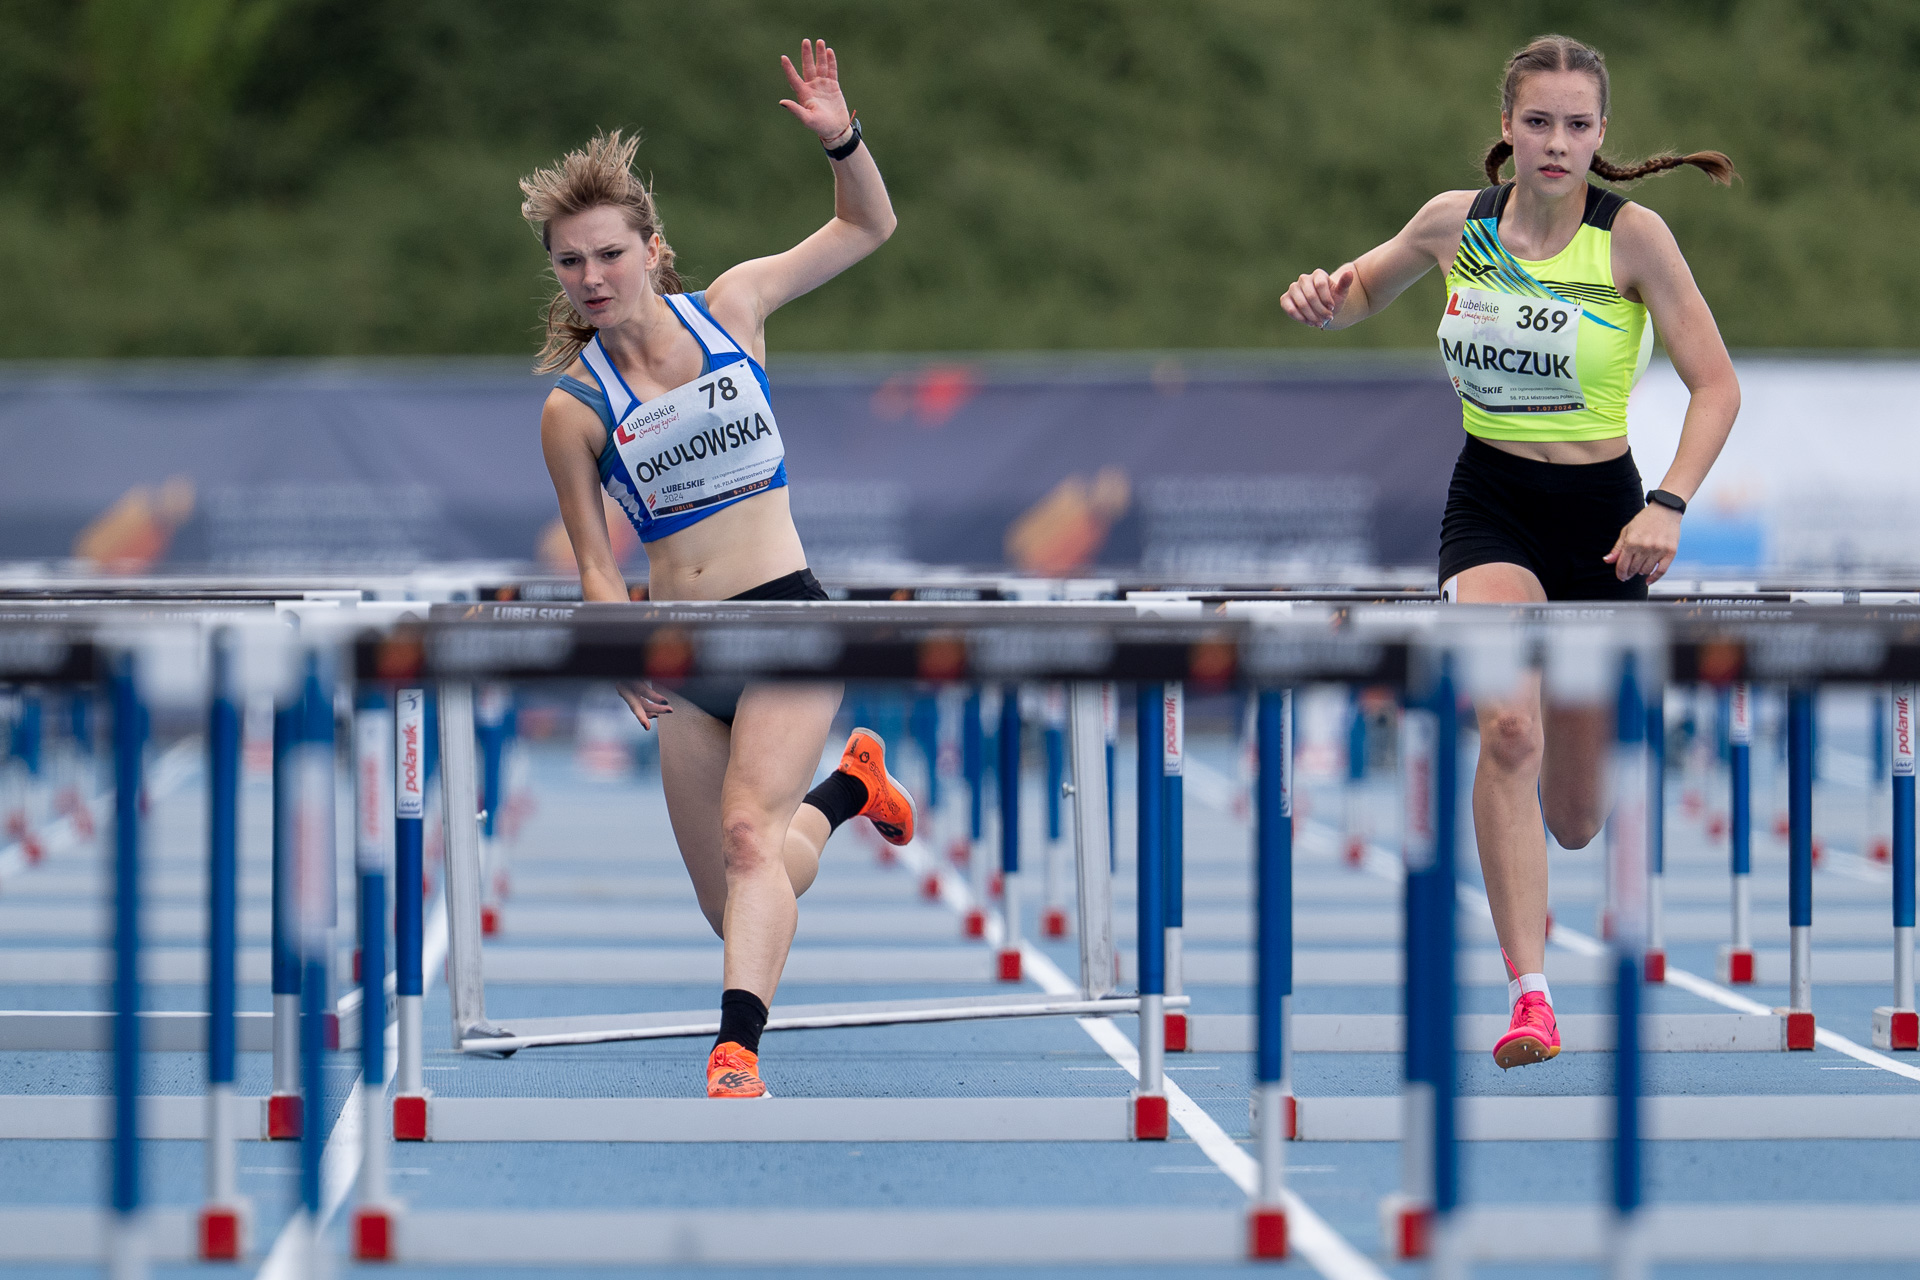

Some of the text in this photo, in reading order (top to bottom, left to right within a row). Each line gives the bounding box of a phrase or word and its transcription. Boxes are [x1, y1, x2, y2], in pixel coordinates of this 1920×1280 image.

[1460, 298, 1568, 333] lubelskie 369
[1442, 338, 1573, 379] MARCZUK
[698, 376, 738, 409] 78
[1464, 379, 1503, 394] LUBELSKIE
[627, 404, 675, 431] lubelskie
[636, 412, 773, 483] OKULOWSKA
[662, 478, 705, 494] LUBELSKIE
[664, 492, 684, 503] 2024
[671, 503, 694, 513] LUBLIN
[493, 606, 574, 620] LUBELSKIE
[1896, 696, 1912, 756] polanik
[402, 723, 420, 795] polanik
